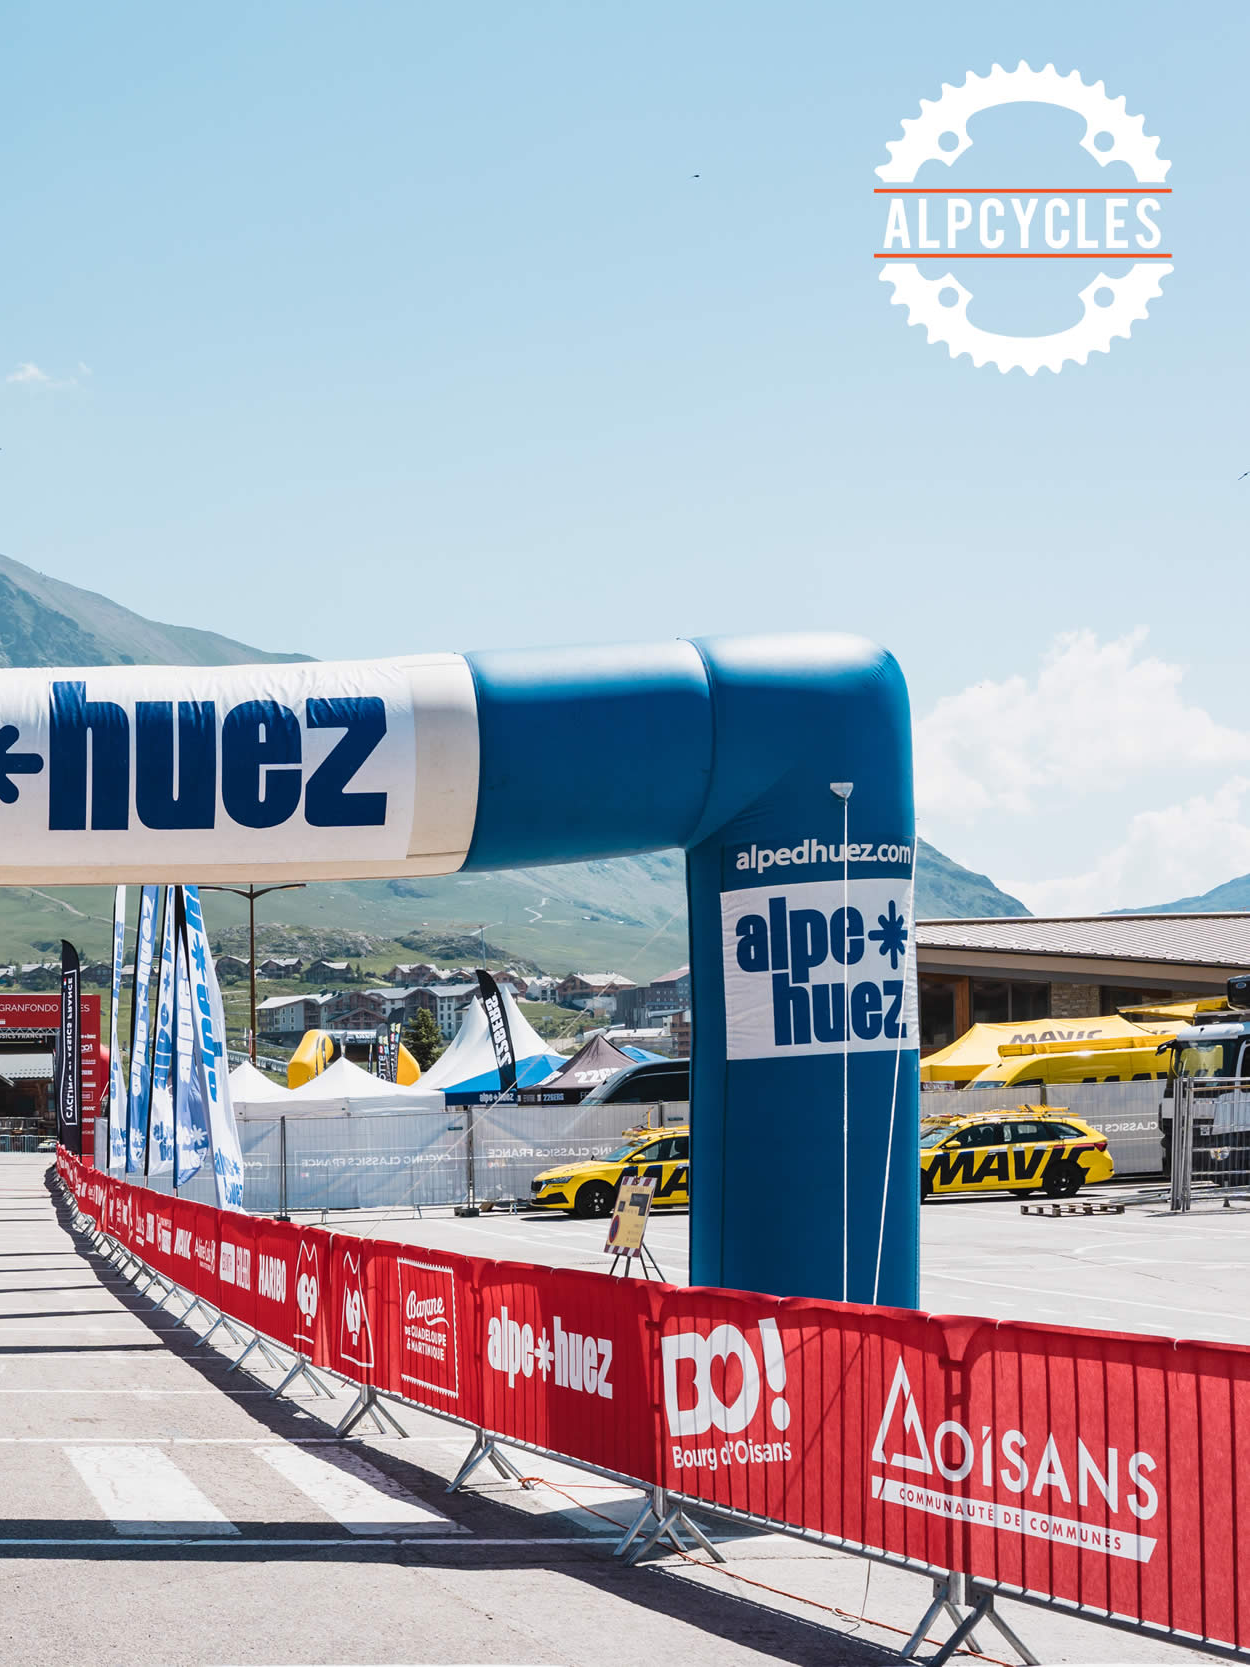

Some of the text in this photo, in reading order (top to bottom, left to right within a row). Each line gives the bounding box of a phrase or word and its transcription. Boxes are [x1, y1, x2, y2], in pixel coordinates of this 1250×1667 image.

[735, 838, 911, 874] alpedhuez.com
[772, 972, 907, 1047] huez
[258, 1253, 286, 1304] HARIBO
[672, 1445, 718, 1471] Bourg
[899, 1487, 1122, 1551] COMMUNAUTÉ DE COMMUNES
